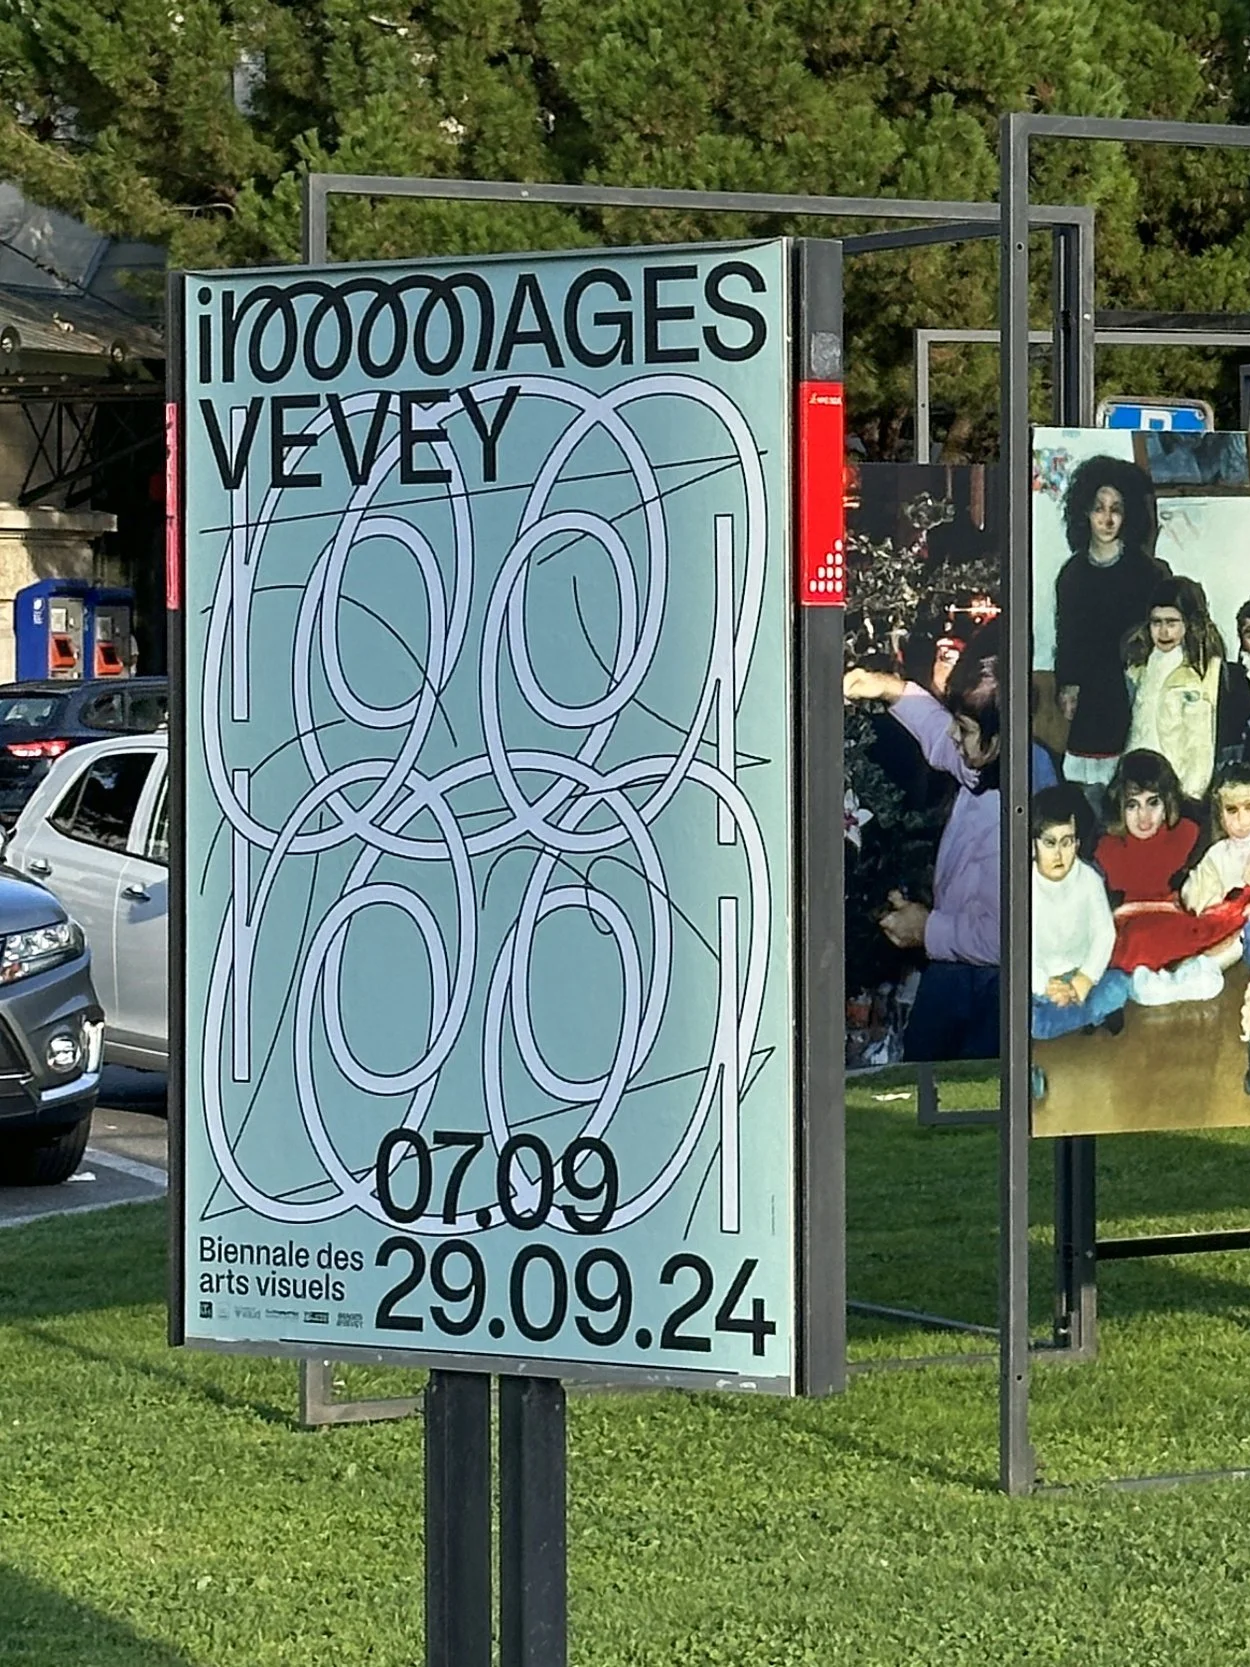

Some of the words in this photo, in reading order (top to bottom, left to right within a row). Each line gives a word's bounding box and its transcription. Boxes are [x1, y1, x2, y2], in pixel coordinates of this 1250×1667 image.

[200, 386, 522, 491] VEVEY
[375, 1127, 619, 1234] 07.09
[200, 1235, 310, 1269] Biennale
[317, 1242, 364, 1272] des
[200, 1269, 249, 1296] arts
[256, 1270, 346, 1301] visuels
[374, 1237, 776, 1357] 29.09.24
